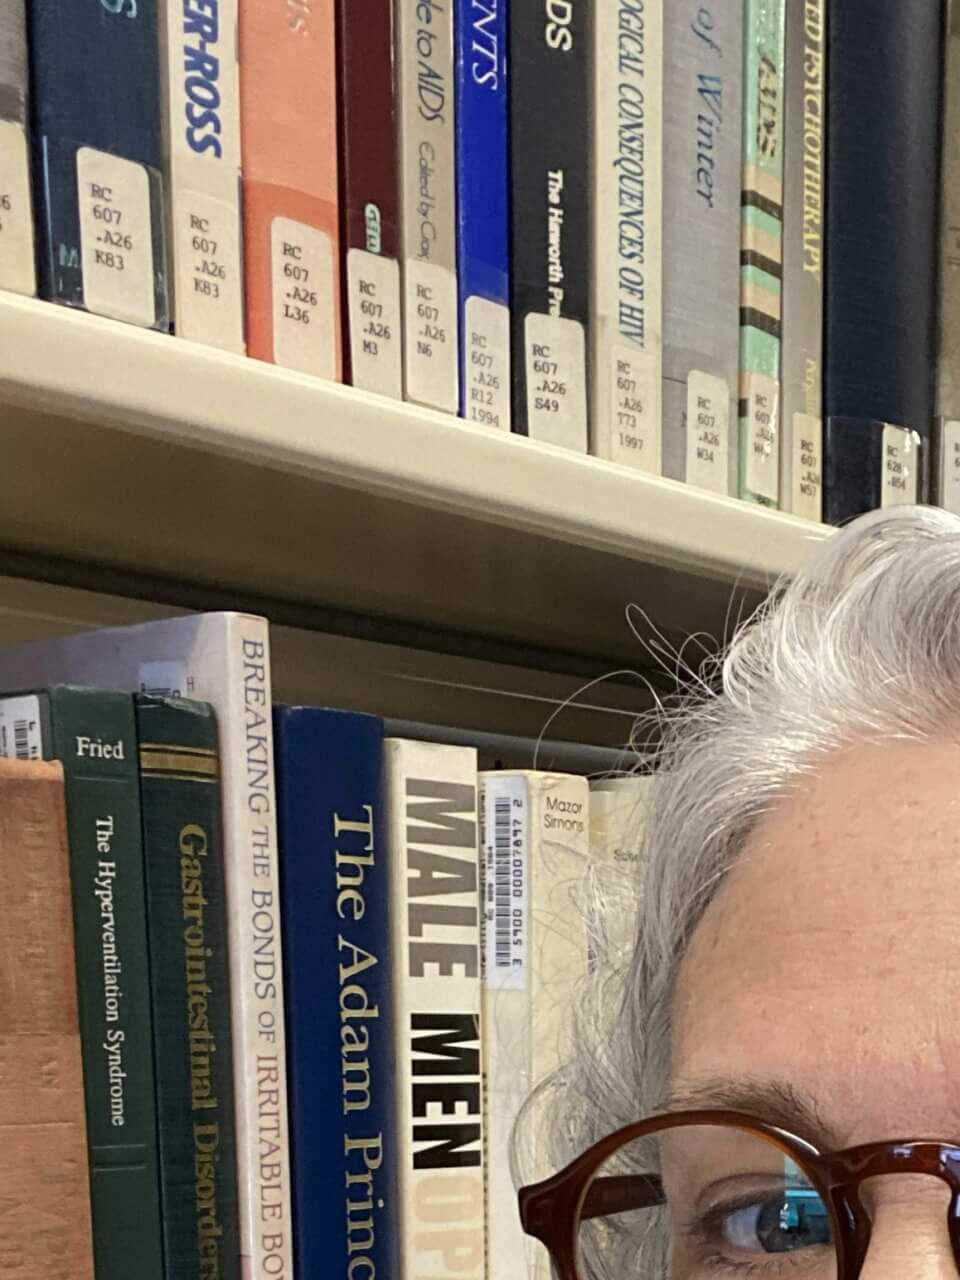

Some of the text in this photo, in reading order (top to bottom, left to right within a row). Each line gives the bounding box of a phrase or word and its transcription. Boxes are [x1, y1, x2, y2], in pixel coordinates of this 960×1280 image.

[417, 29, 445, 125] to AIDS
[691, 8, 723, 208] of Winter
[803, 45, 824, 276] PSYCHOTHERAPY
[612, 83, 645, 264] CONSEQUENCES
[90, 183, 113, 202] RC
[93, 207, 122, 225] 607
[417, 201, 436, 219] by
[190, 214, 209, 233] RC
[547, 169, 565, 283] The Haworth
[96, 231, 133, 250] .A26
[192, 236, 218, 256] 607
[95, 249, 125, 271] K83
[283, 242, 302, 260] RC
[195, 260, 226, 280] .A26
[284, 263, 309, 283] 607
[194, 278, 220, 298] K83
[359, 280, 376, 296] RC
[416, 284, 432, 301] RC
[618, 268, 645, 302] OF
[286, 286, 318, 307] .A26
[284, 304, 310, 325] L36
[361, 300, 383, 318] 607
[417, 303, 439, 322] 607
[363, 322, 391, 340] .A26
[419, 325, 446, 343] .A26
[618, 303, 645, 347] HIV
[363, 340, 379, 356] M3
[417, 341, 433, 358] N6
[471, 332, 487, 348] RC
[471, 351, 493, 369] 607
[533, 344, 550, 358] RC
[534, 360, 558, 376] 607
[617, 360, 631, 375] RC
[472, 372, 500, 390] .A26
[536, 381, 566, 396] .A26
[617, 377, 637, 392] 607
[471, 388, 493, 406] R12
[535, 396, 559, 413] S49
[618, 397, 643, 413] .A26
[697, 396, 711, 410] RC
[755, 394, 767, 408] RC
[471, 408, 499, 428] 1994
[697, 413, 715, 427] 607
[619, 433, 644, 450] 1997
[698, 431, 720, 447] .A26
[801, 439, 814, 453] RC
[801, 454, 817, 467] 607
[242, 638, 270, 814] BREAKING
[76, 736, 125, 760] Fried
[513, 799, 523, 808] 2
[544, 814, 584, 834] Simons
[251, 825, 271, 878] THE
[334, 804, 376, 920] The
[405, 777, 479, 979] MALE
[513, 908, 523, 946] 5900
[251, 889, 278, 998] BONDS
[94, 815, 125, 1126] The Hyperventilation Syndrome
[179, 823, 219, 1110] Gastrointestinal
[513, 958, 523, 967] 3
[257, 1011, 276, 1044] OF
[337, 934, 379, 1115] Adam
[256, 1054, 284, 1223] IRRITABLE
